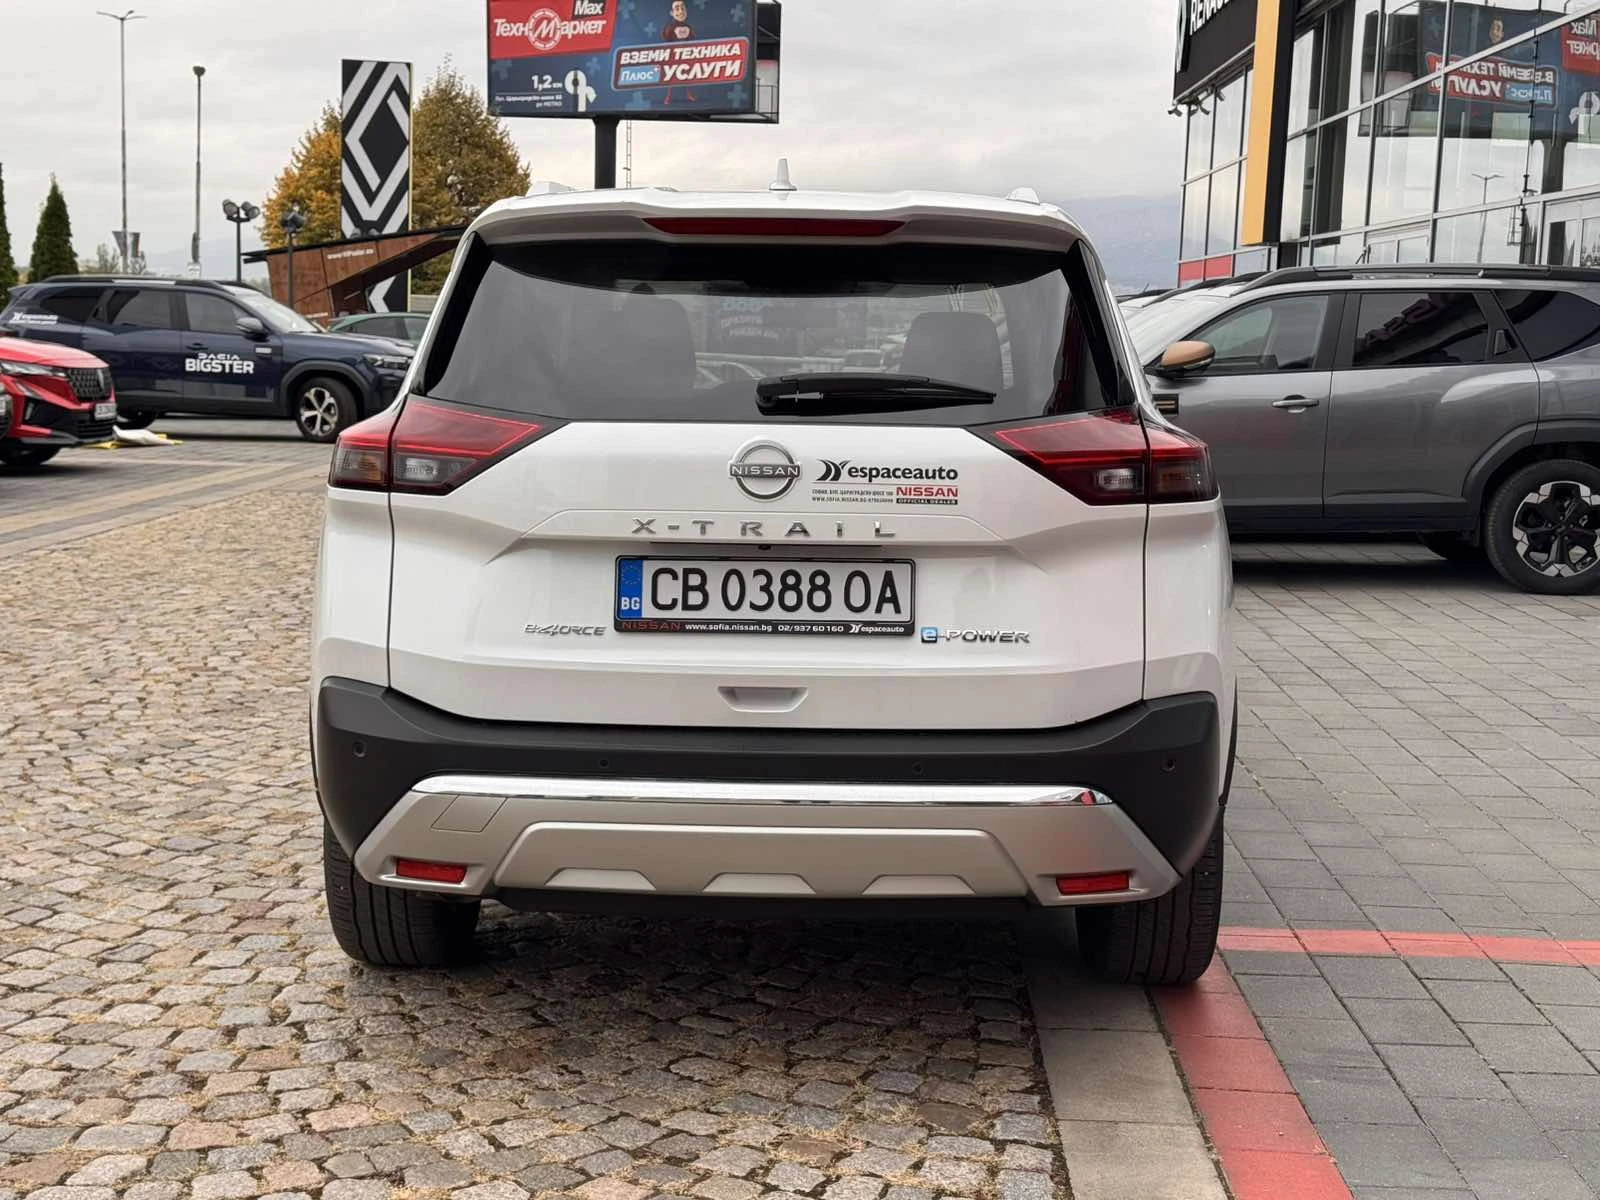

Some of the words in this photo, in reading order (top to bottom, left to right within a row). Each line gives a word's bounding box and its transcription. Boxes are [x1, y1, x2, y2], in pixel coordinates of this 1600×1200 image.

[575, 0, 603, 16] Max
[620, 48, 670, 65] ВЗЕМИ
[674, 43, 741, 61] ТЕХНИКА
[663, 60, 741, 82] УСЛУГИ
[531, 74, 552, 91] 1,2
[185, 358, 254, 374] BIGSTER
[731, 465, 799, 477] NISSAN
[847, 465, 959, 482] espaceauto
[896, 486, 958, 498] NISSAN
[632, 518, 896, 538] X-TRAIL
[651, 567, 709, 611] CB
[721, 568, 832, 613] 0388
[844, 570, 901, 614] OA
[620, 597, 640, 611] BG
[622, 621, 681, 631] NISSAN
[684, 622, 772, 632] www.sofia.nissan.bg
[860, 625, 905, 633] espaceauto
[920, 626, 1031, 644] e-POWER
